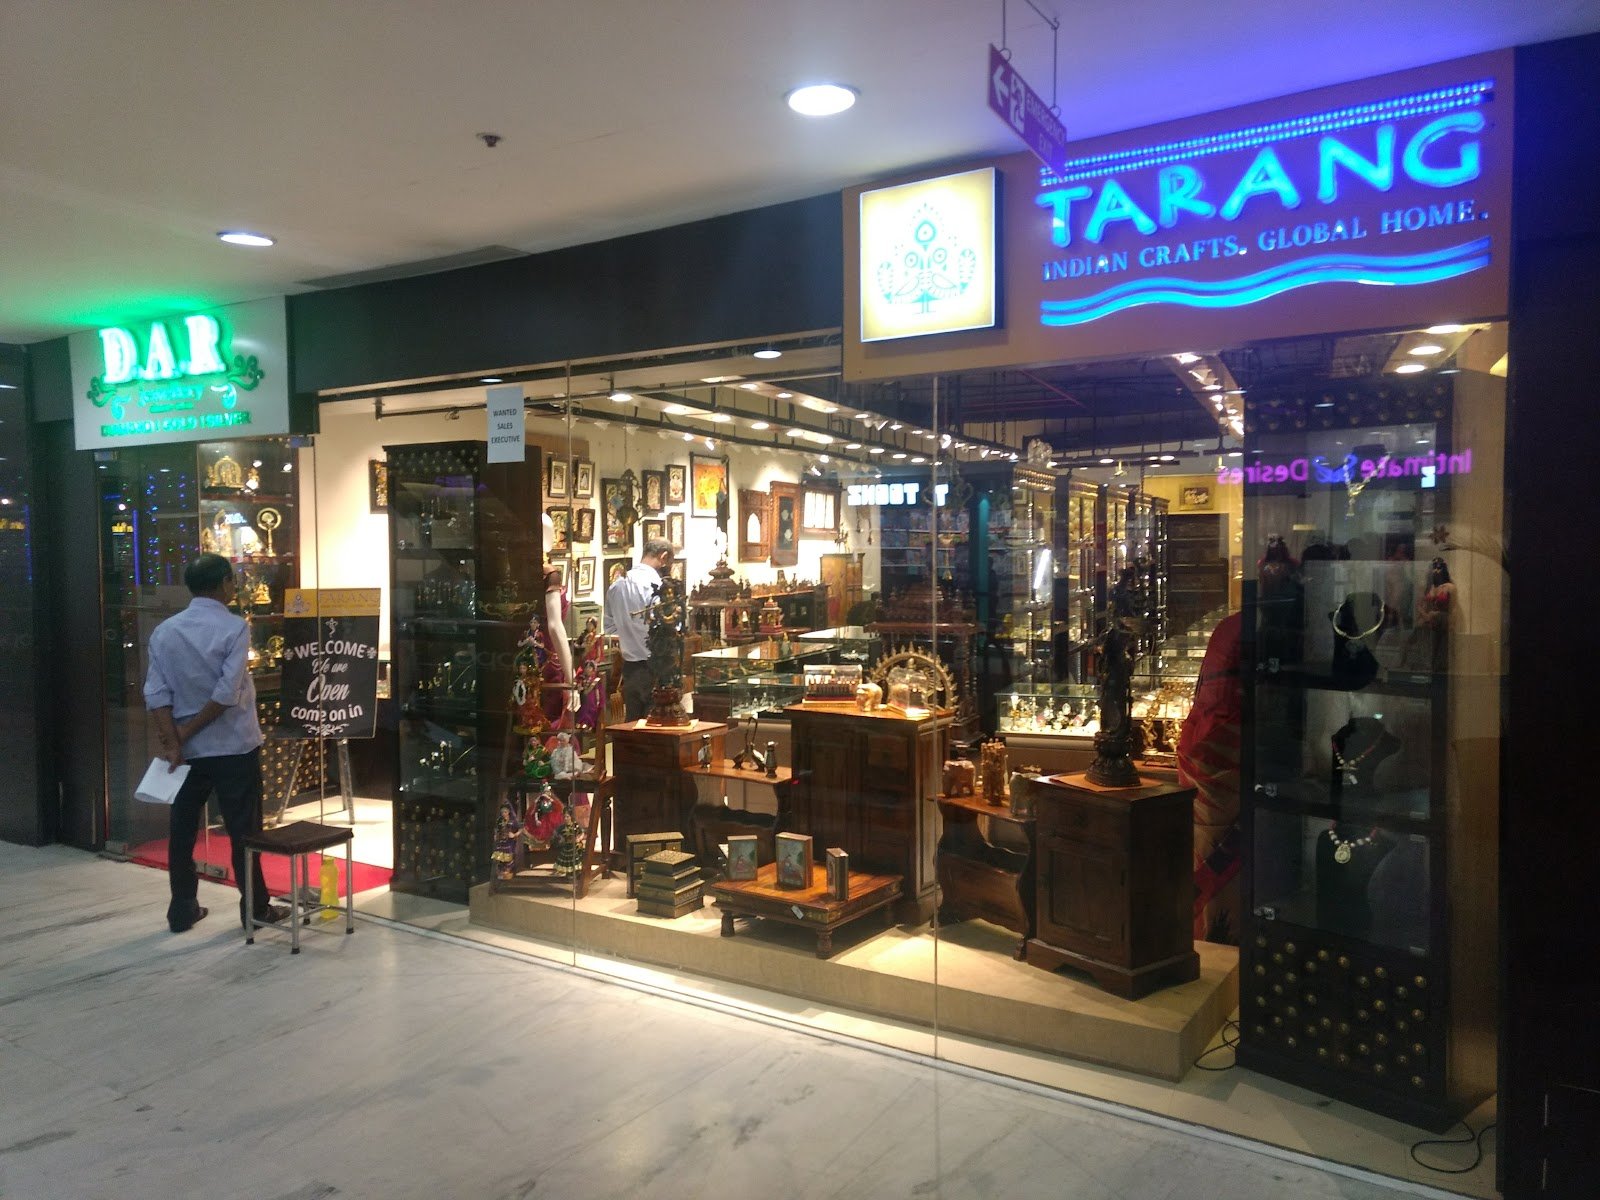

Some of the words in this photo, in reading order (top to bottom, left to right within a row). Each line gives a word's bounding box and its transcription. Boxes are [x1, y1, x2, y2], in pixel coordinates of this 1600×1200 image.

[1036, 111, 1486, 247] TARANG
[1042, 251, 1128, 282] INDIAN
[1138, 235, 1248, 270] CRAFTS.
[1257, 217, 1368, 252] GLOBAL
[493, 408, 518, 417] WANTED
[497, 422, 514, 430] SALES
[491, 435, 521, 444] EXECUTIVE
[294, 640, 368, 660] WELCOME
[331, 662, 349, 674] are
[290, 705, 328, 722] come
[329, 709, 347, 723] on
[348, 704, 364, 719] in
